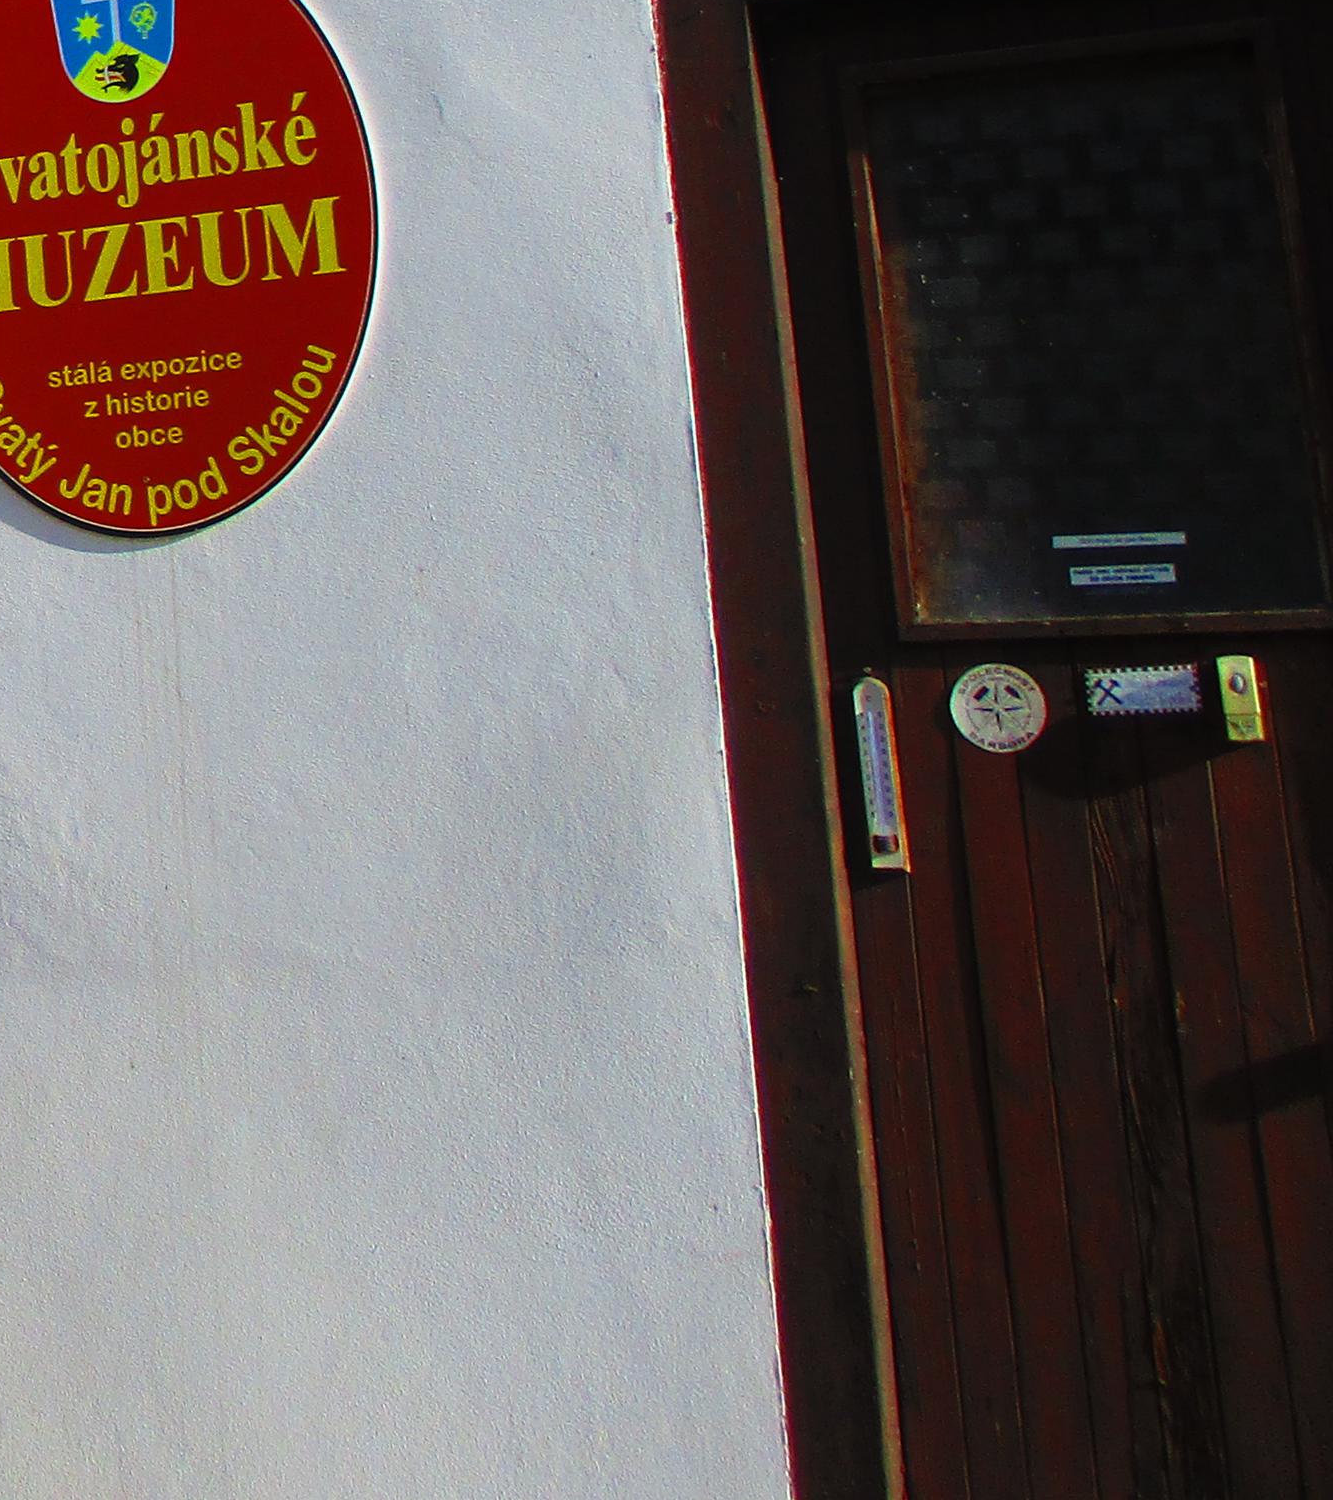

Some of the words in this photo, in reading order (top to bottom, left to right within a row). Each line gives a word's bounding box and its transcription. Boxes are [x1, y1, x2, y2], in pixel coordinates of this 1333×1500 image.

[47, 359, 114, 390] stálá
[119, 348, 244, 384] expozice
[84, 399, 99, 419] z
[106, 385, 210, 416] historie
[58, 462, 133, 516] Jan
[147, 456, 230, 526] pod
[226, 343, 338, 479] Skalou
[114, 425, 185, 449] obce
